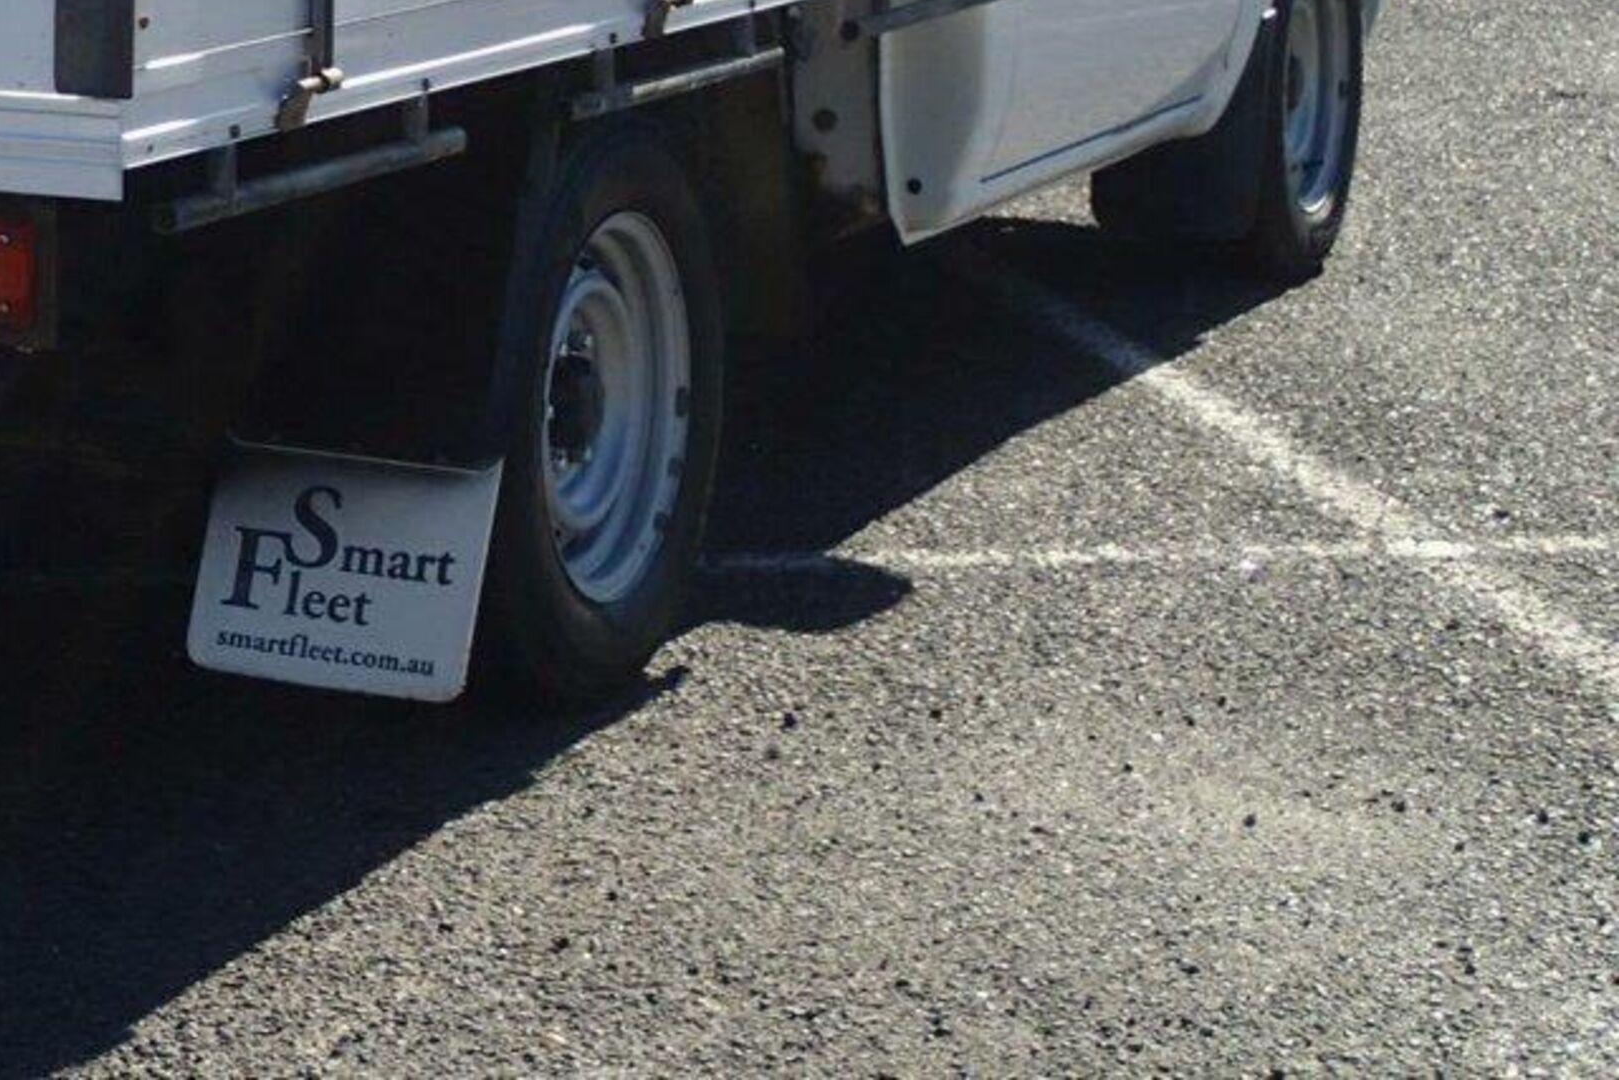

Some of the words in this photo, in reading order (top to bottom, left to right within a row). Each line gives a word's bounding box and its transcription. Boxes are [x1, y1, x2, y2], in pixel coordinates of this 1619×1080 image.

[220, 526, 372, 626] Fleet
[286, 486, 455, 585] Smart
[216, 628, 435, 676] smartfleet.com.au
